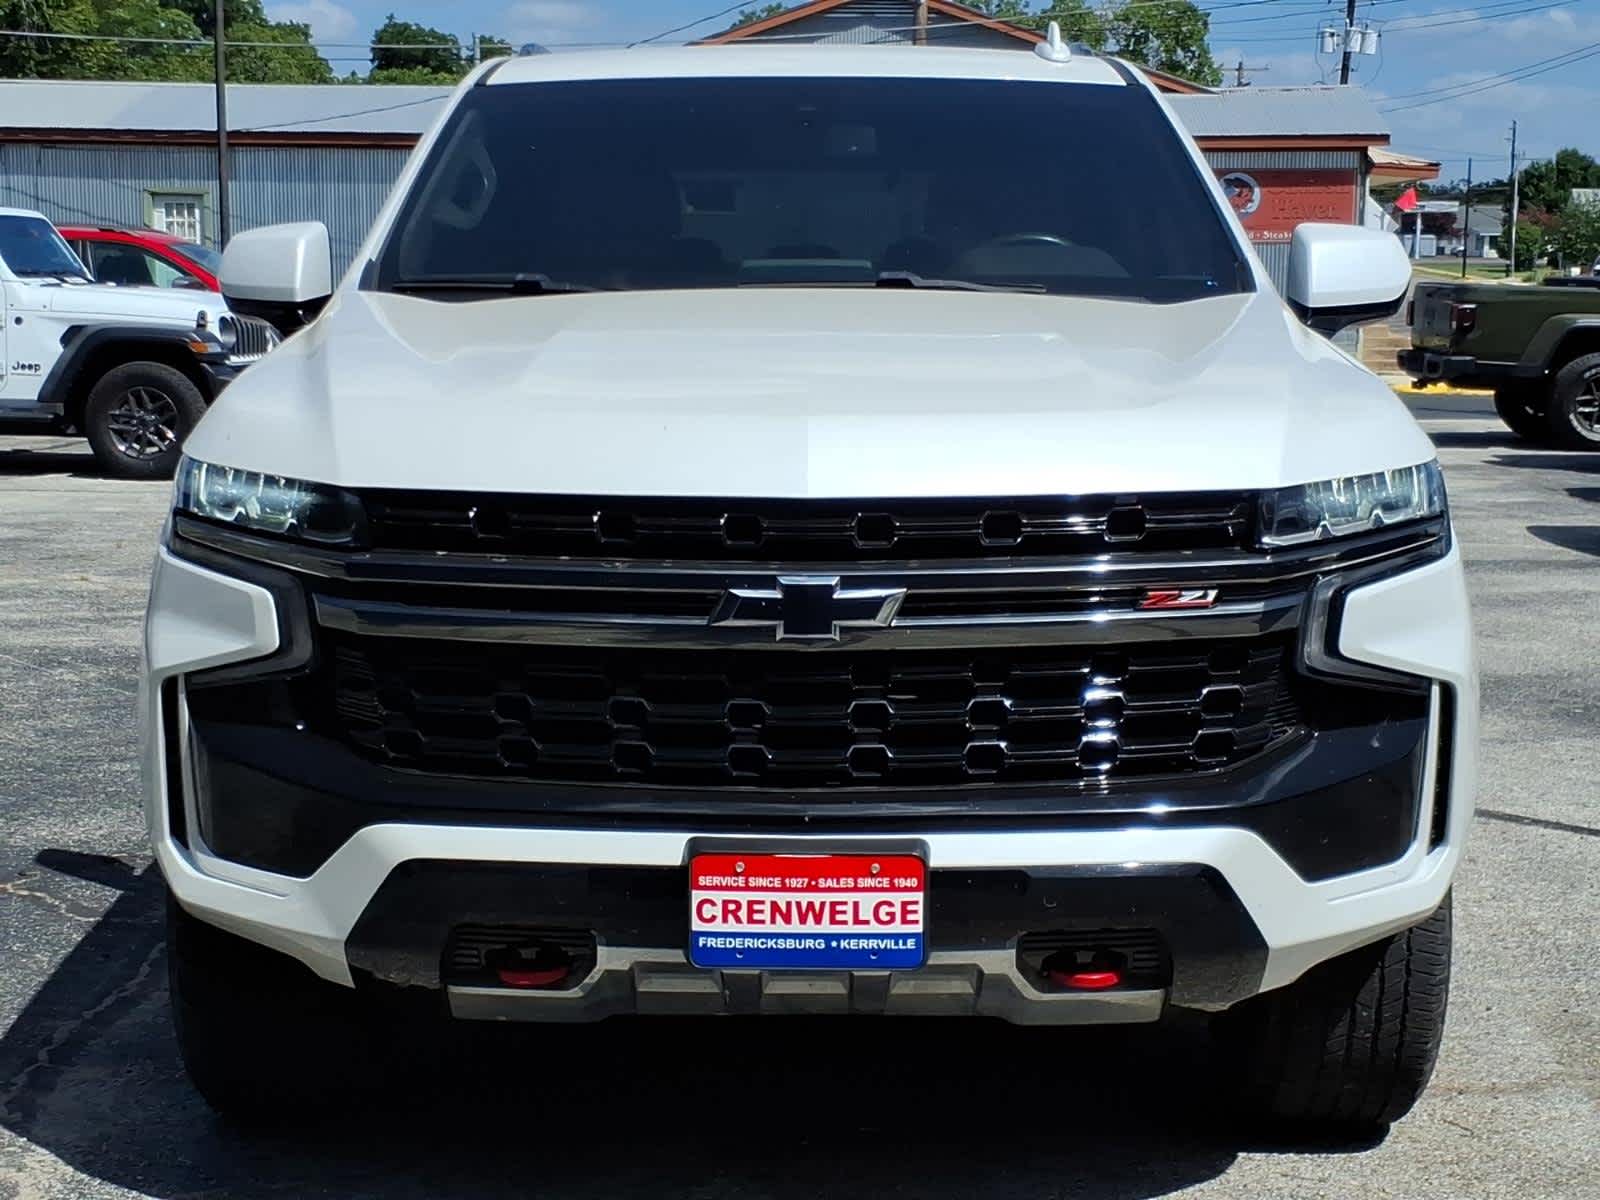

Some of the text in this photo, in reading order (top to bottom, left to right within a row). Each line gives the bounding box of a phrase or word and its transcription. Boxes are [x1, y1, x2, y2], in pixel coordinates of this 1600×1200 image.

[11, 360, 41, 373] Jeep
[1142, 589, 1219, 608] Z71
[698, 875, 918, 888] SERVICE SINCE 1927 SALES SINCE 1940
[695, 898, 920, 926] CRENWELGE
[698, 936, 916, 950] FREDERICKSBURG KERRVILLE
